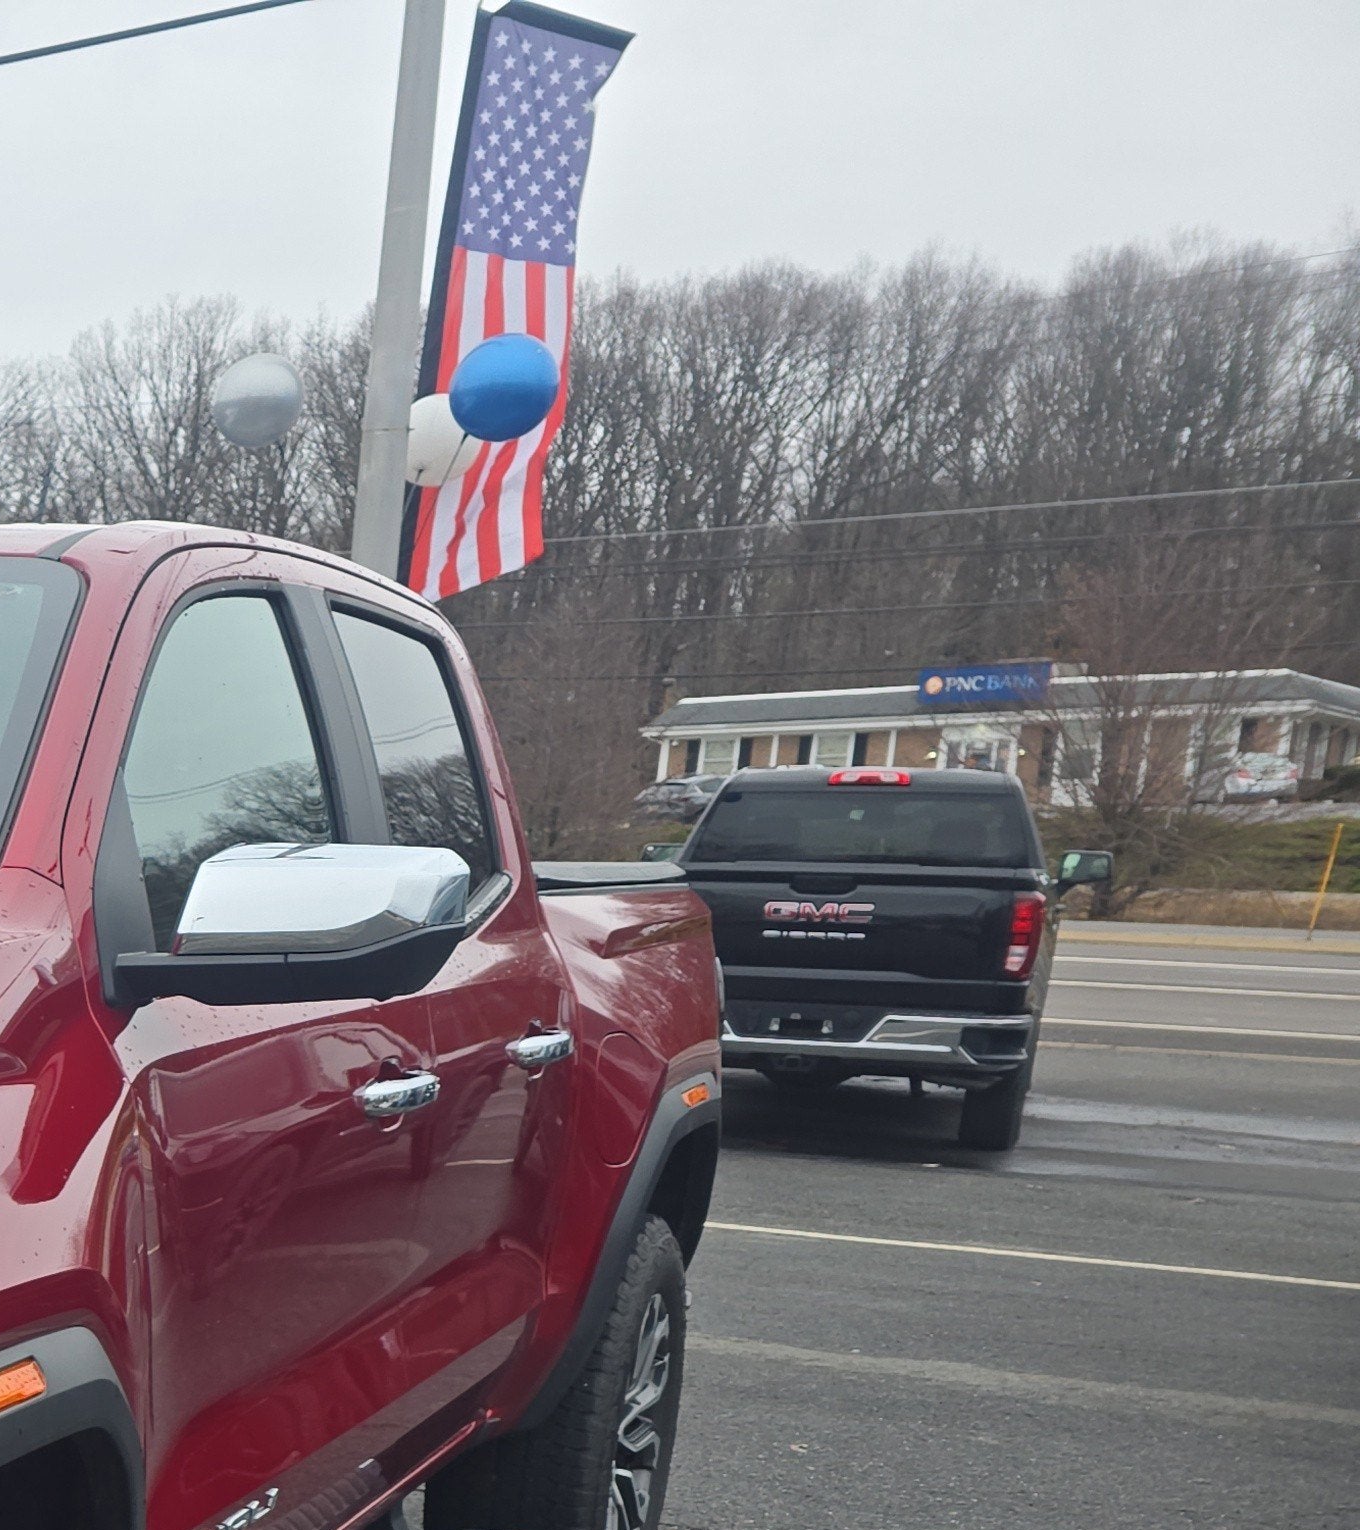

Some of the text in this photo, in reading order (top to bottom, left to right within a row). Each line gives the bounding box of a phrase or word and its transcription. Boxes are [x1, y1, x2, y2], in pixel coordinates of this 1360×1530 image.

[944, 674, 1040, 693] PNC BANK
[764, 900, 875, 923] GMC
